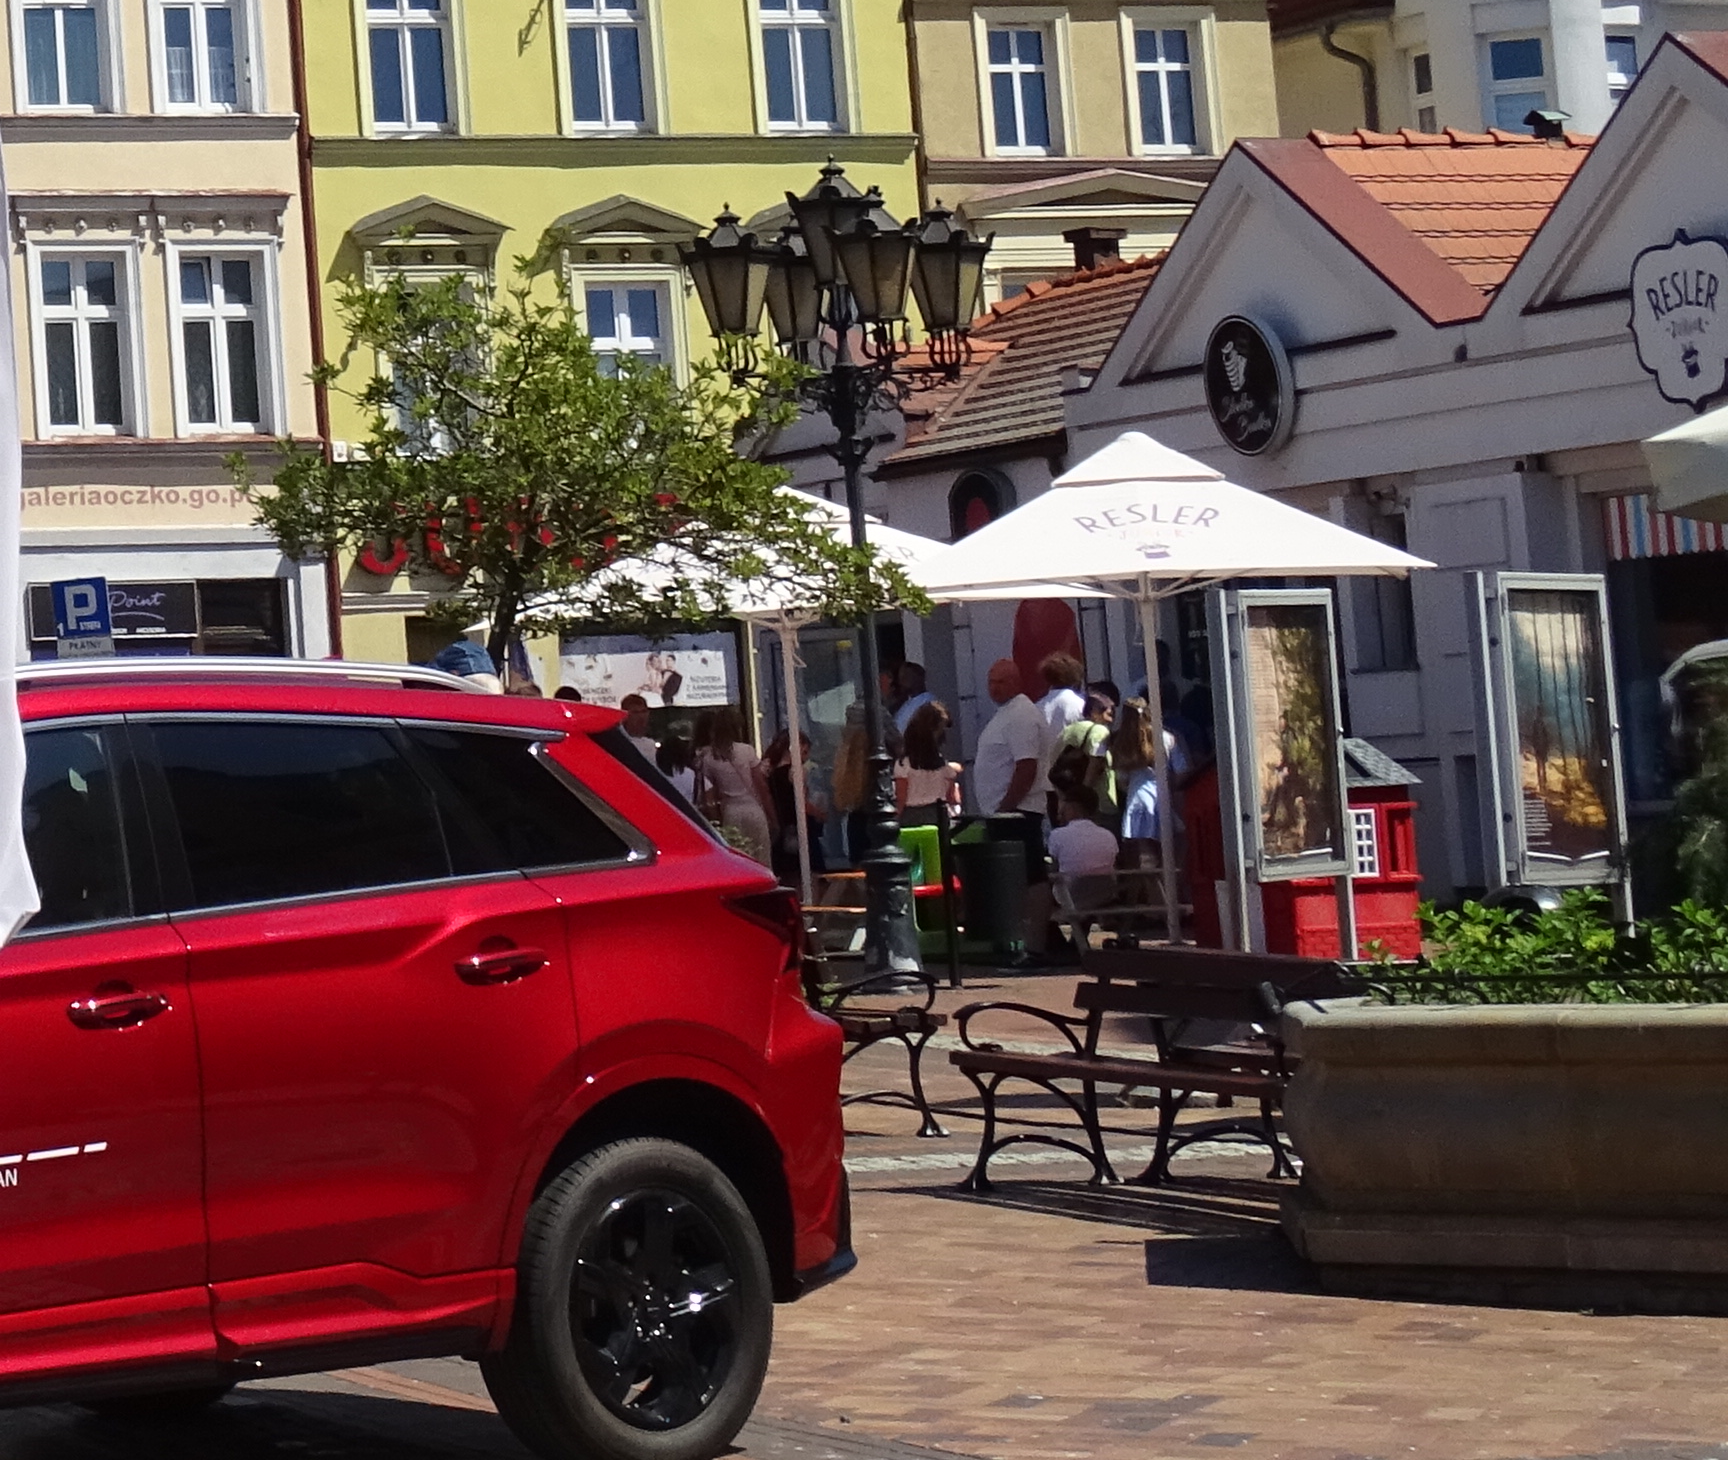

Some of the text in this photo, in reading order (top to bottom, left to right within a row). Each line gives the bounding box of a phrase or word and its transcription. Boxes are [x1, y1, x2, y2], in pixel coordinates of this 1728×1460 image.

[1645, 269, 1720, 321] RESLER
[21, 486, 252, 511] aleriaoczko.go.p
[1072, 503, 1220, 533] RESLER
[64, 584, 97, 630] P
